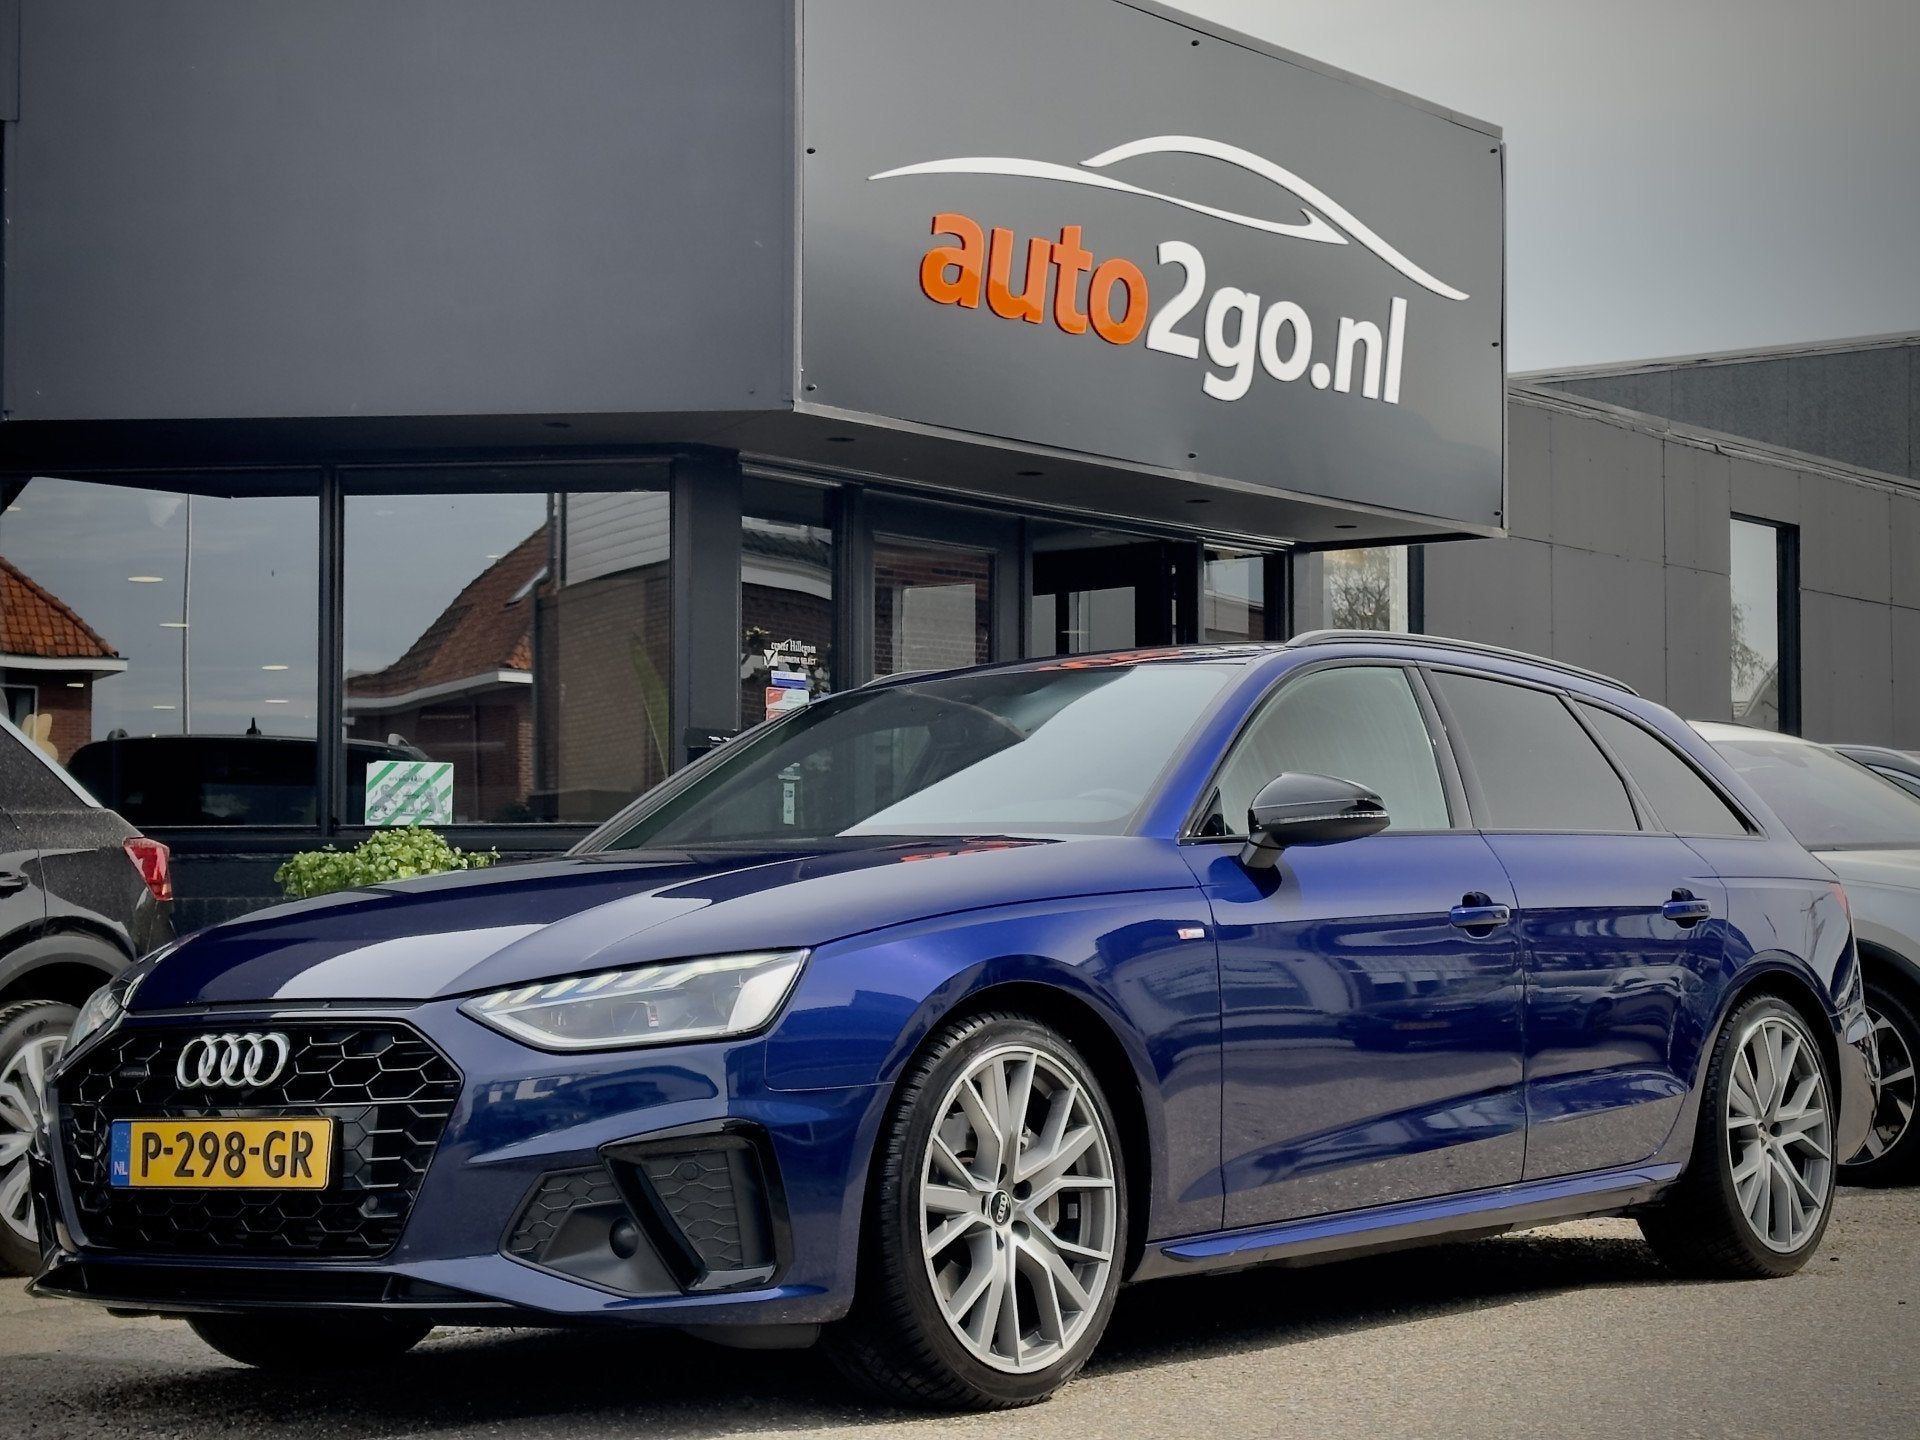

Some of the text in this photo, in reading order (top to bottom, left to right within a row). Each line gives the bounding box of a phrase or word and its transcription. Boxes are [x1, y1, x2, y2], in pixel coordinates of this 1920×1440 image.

[919, 212, 1407, 404] auto2go.nl
[113, 1161, 129, 1176] NL
[141, 1130, 314, 1179] P-298-GR
